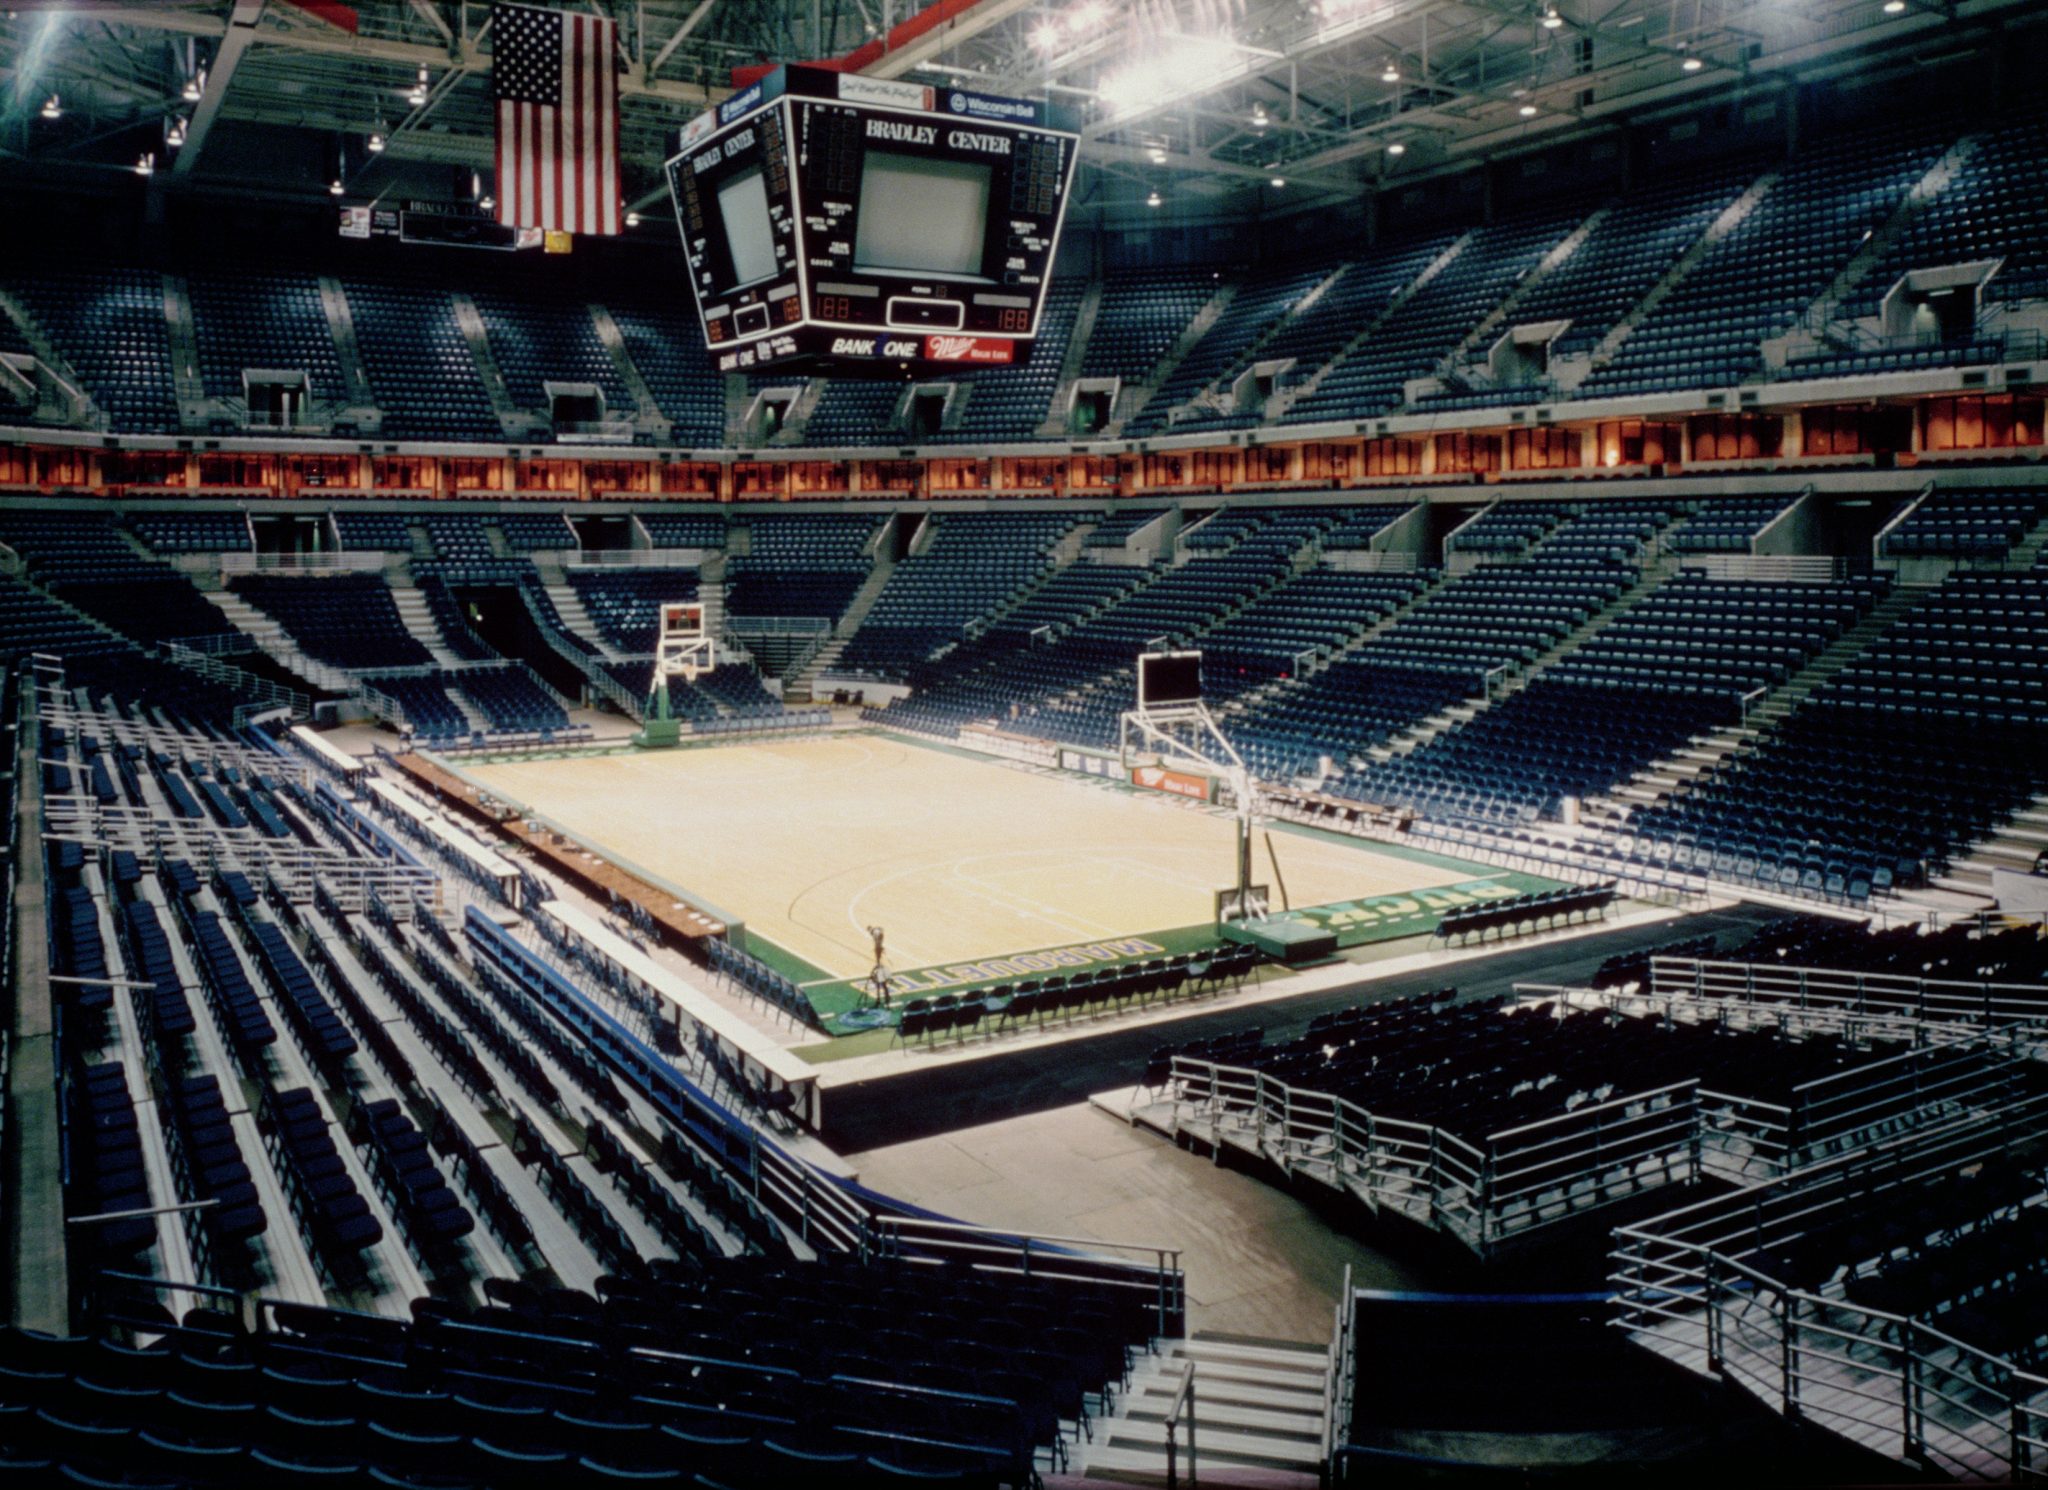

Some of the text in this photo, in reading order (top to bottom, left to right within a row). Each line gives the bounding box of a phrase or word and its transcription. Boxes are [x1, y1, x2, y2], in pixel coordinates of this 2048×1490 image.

[866, 119, 938, 144] BRADLEY
[948, 131, 1011, 154] CENTER
[831, 338, 918, 357] BANK ONE
[929, 335, 976, 360] Miller
[850, 937, 1166, 998] MARQUETTE
